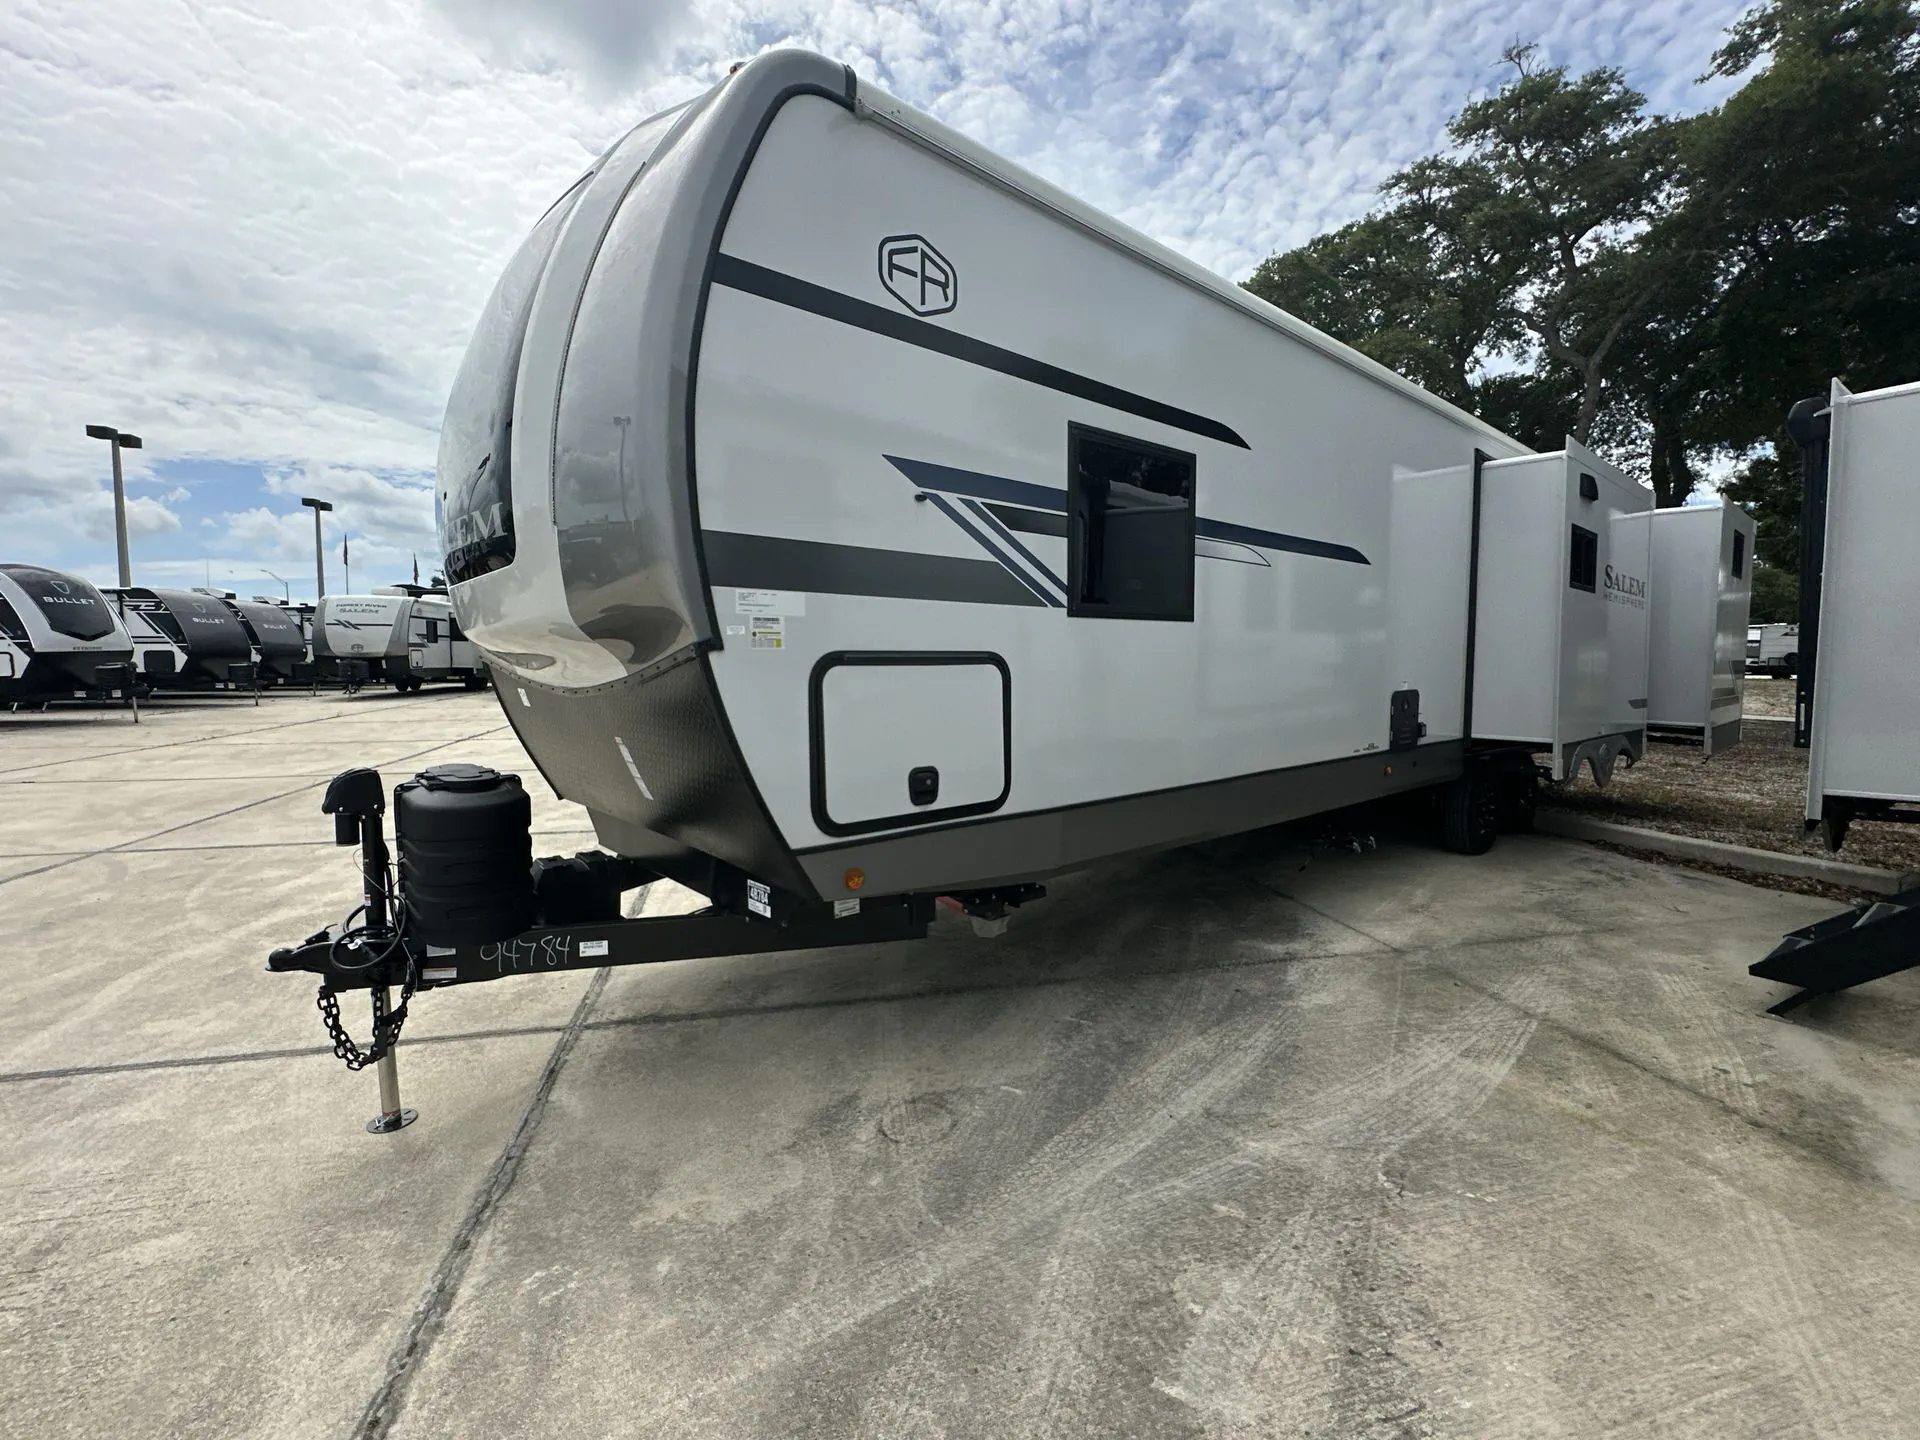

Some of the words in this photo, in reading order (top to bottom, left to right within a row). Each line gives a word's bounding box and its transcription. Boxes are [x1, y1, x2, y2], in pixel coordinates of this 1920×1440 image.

[1604, 564, 1646, 599] SALEM
[42, 596, 95, 606] BULLET
[480, 935, 570, 973] 94784
